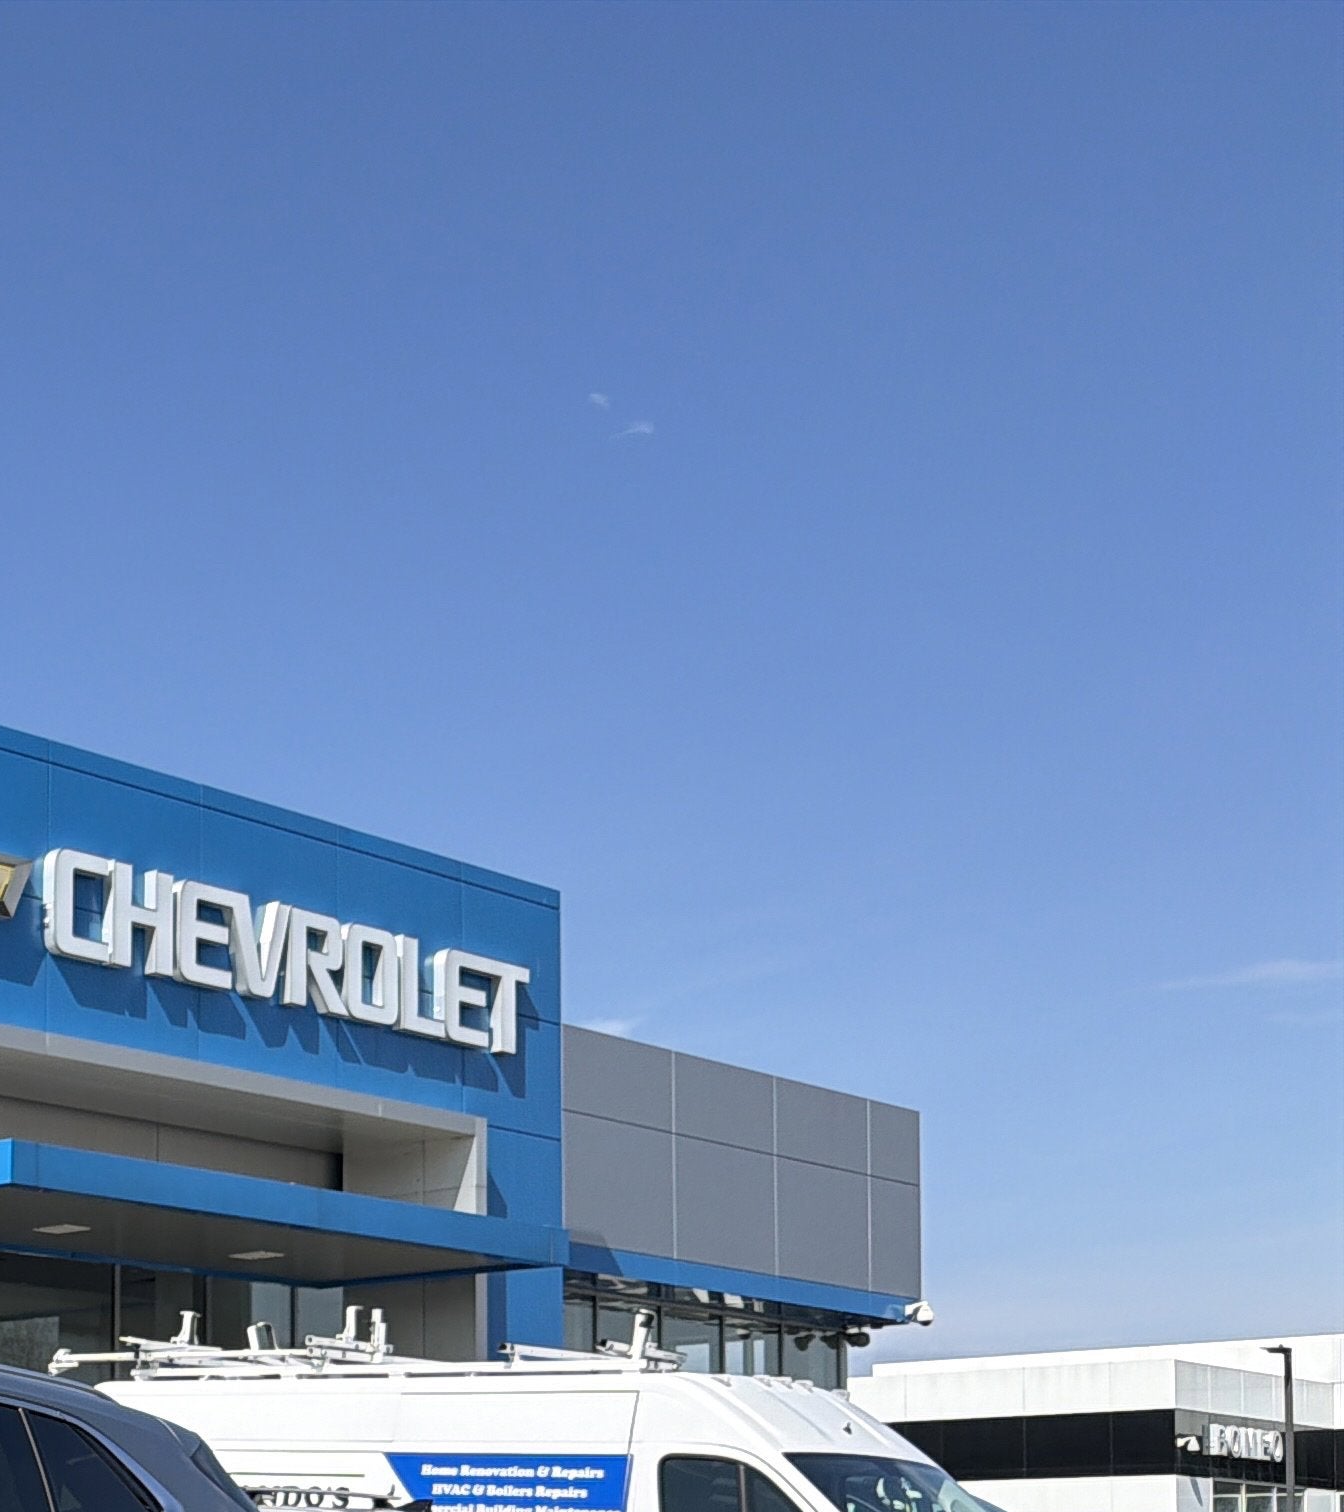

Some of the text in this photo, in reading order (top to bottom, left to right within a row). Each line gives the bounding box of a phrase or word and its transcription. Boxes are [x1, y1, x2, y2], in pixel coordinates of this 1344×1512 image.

[42, 848, 530, 1055] CHEVROLET
[1209, 1423, 1284, 1463] ROMEO
[420, 1463, 605, 1481] Home Renovation & Repairs
[431, 1483, 588, 1500] HVAC & Boilers Repairs
